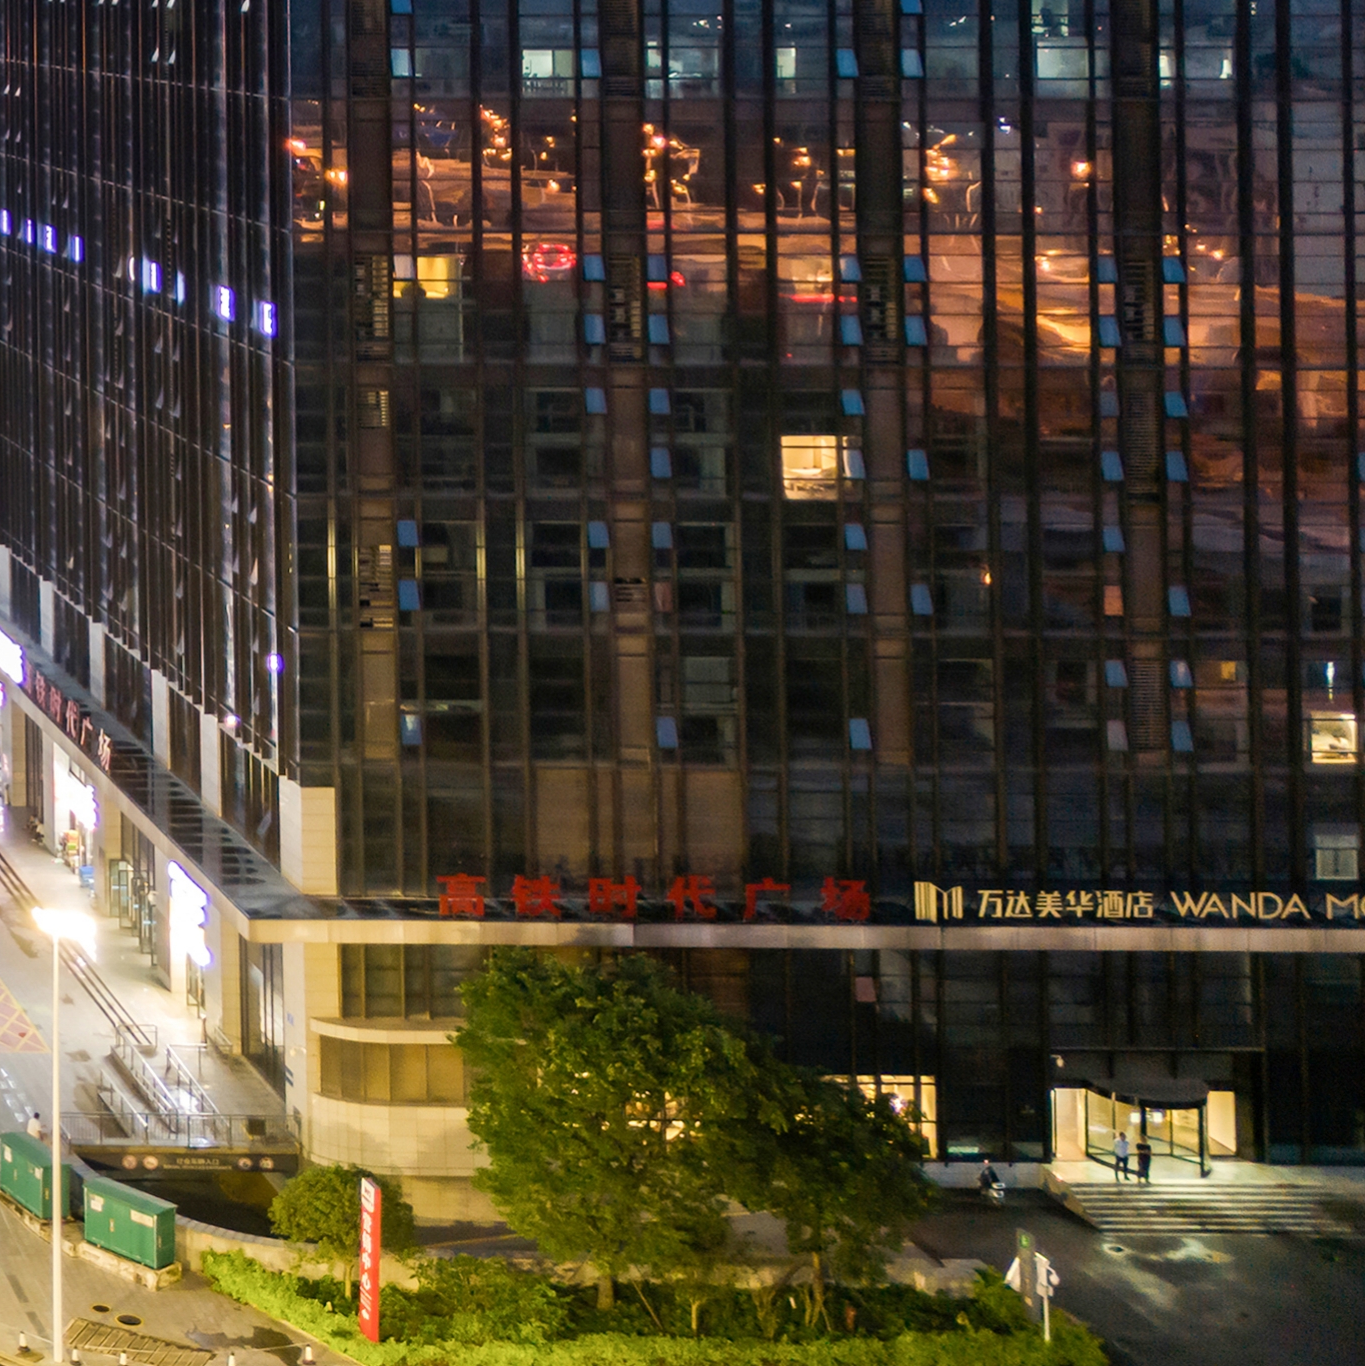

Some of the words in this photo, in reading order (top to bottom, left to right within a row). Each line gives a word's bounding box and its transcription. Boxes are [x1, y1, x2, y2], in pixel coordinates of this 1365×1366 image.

[436, 873, 870, 919] 高铁时代广场
[977, 889, 1155, 919] 万达美华酒店
[1170, 891, 1311, 919] WANDA
[1325, 892, 1365, 919] M
